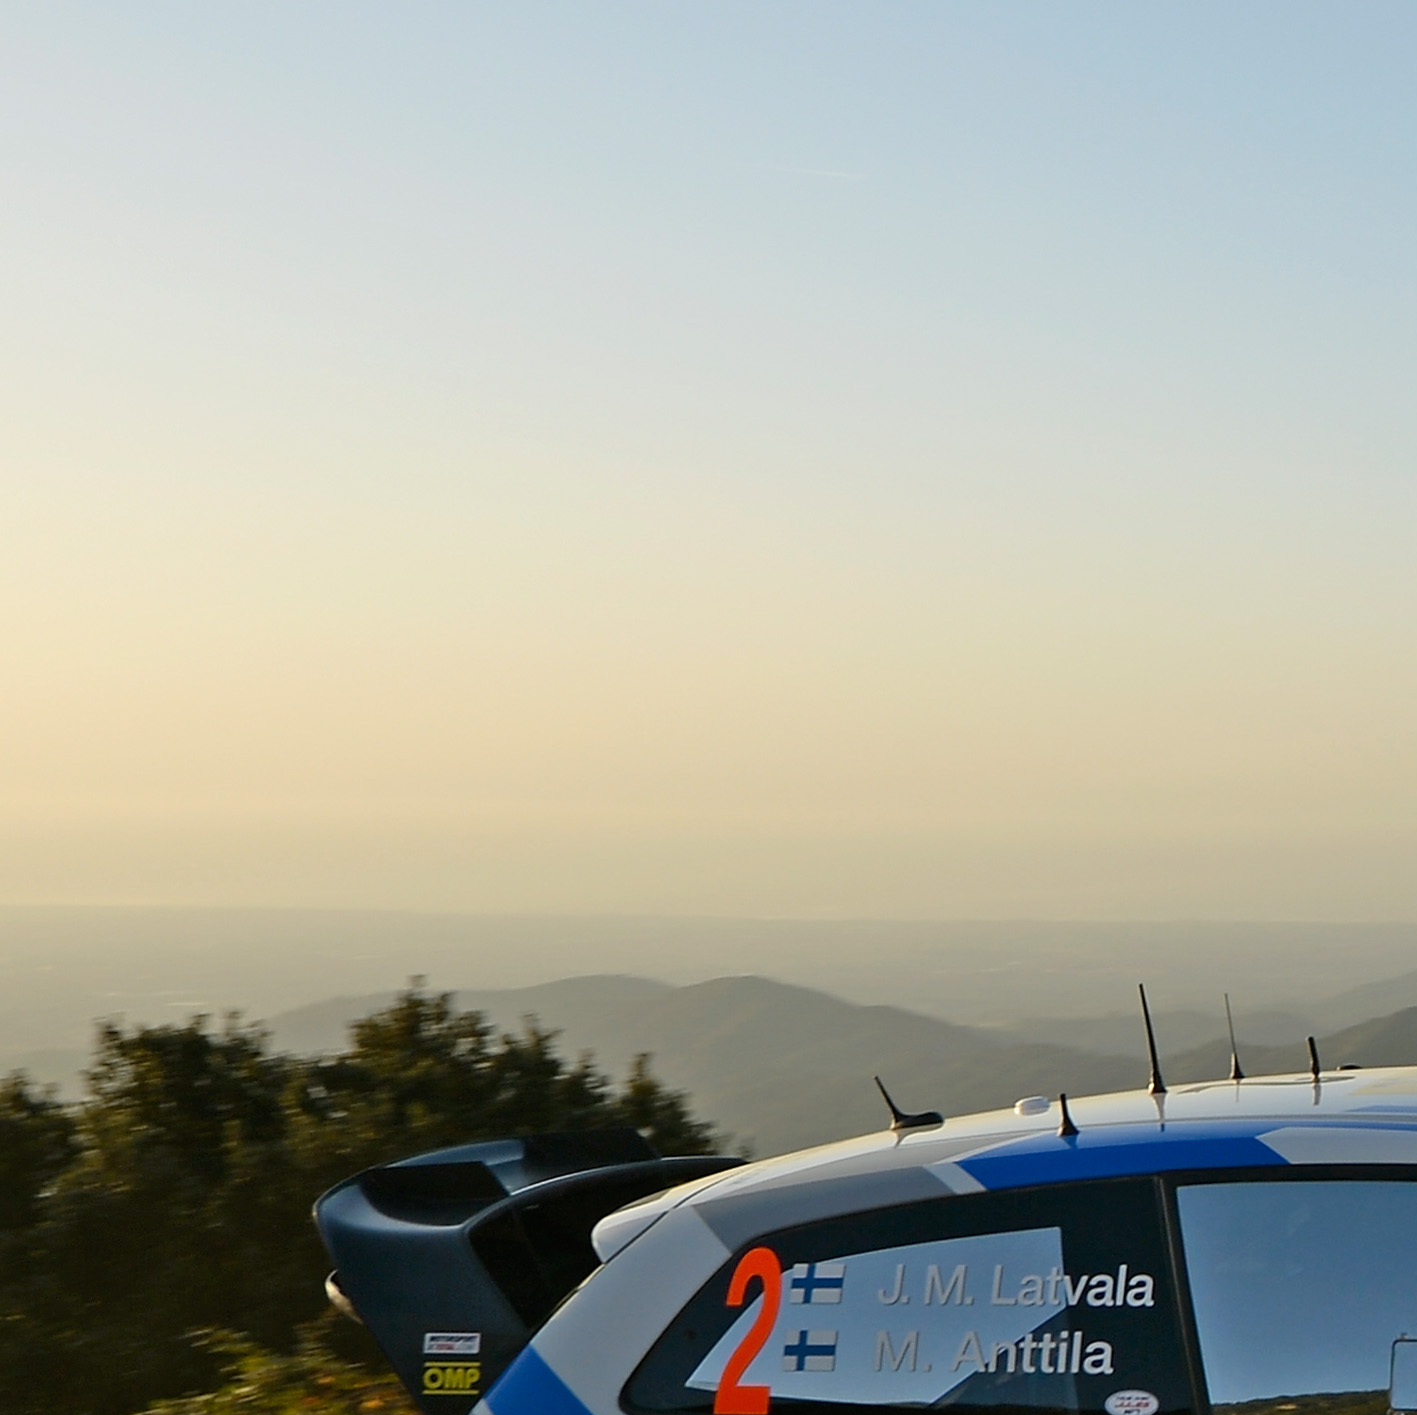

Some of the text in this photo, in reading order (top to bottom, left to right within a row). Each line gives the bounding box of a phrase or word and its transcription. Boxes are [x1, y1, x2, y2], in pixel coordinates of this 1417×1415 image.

[877, 1263, 1156, 1309] J. M. Latvala
[874, 1329, 1115, 1376] M. Anttila
[423, 1368, 480, 1389] OMP
